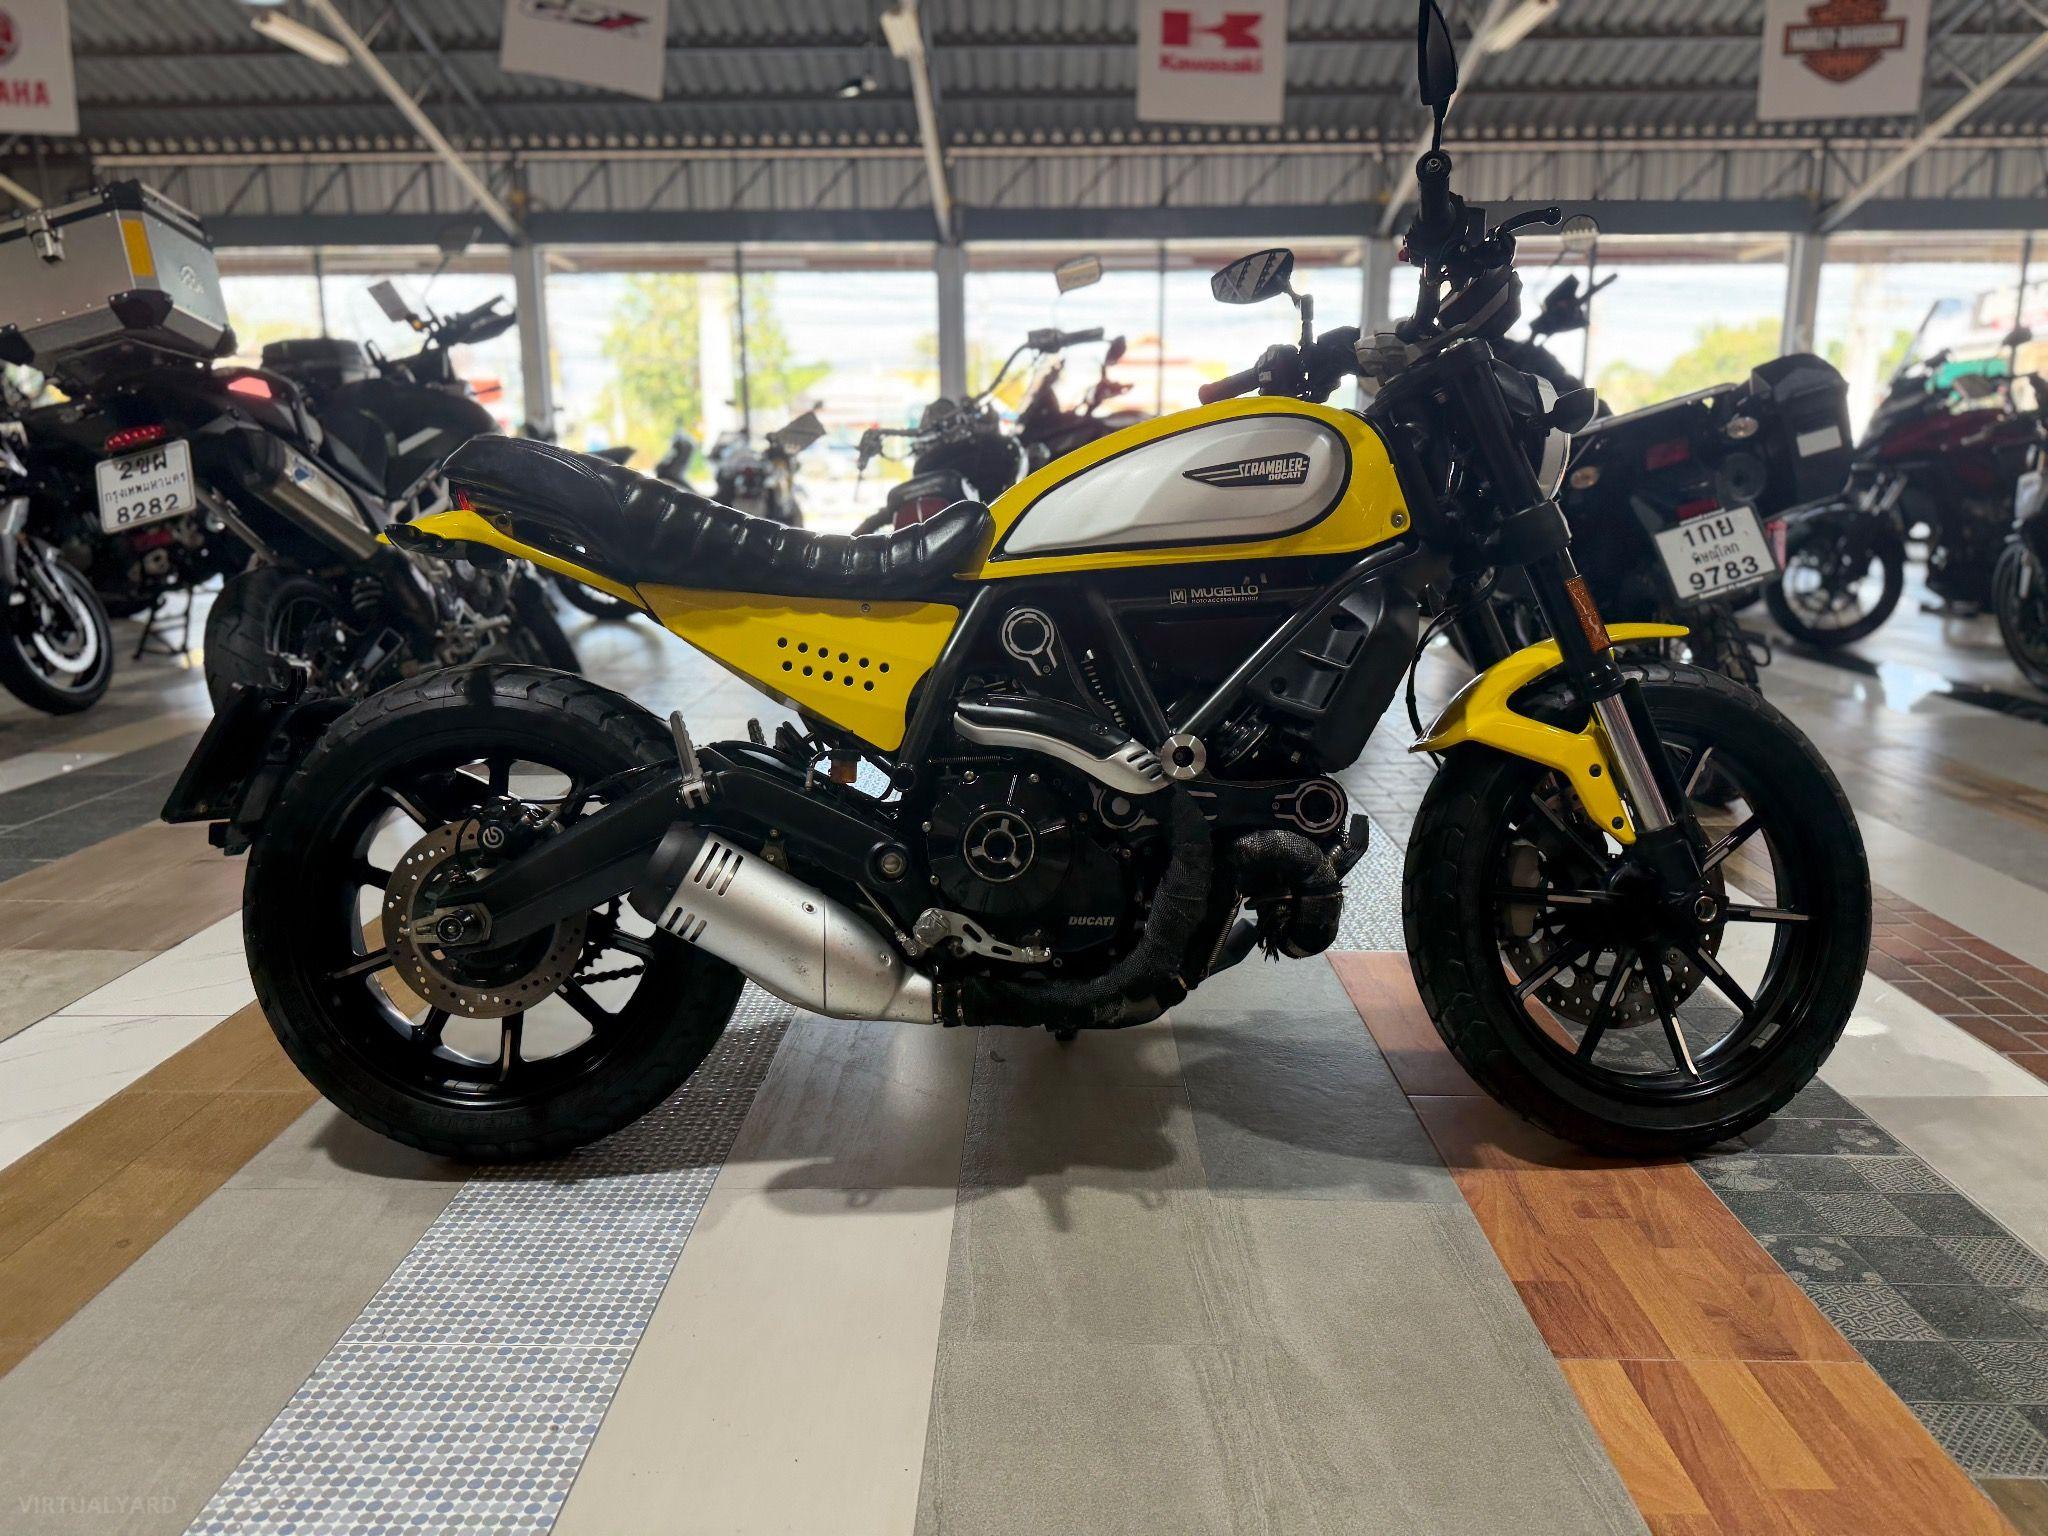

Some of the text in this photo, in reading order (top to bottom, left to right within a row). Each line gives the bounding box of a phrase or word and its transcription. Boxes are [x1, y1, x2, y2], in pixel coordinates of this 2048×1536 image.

[1239, 457, 1304, 477] SCRAMBLER
[1268, 471, 1301, 481] DUCATI
[117, 493, 179, 524] 8282
[1683, 517, 1734, 547] 1กย
[1689, 556, 1759, 590] 9783
[1190, 585, 1259, 598] MUGELLO
[1068, 916, 1115, 926] DUCATI
